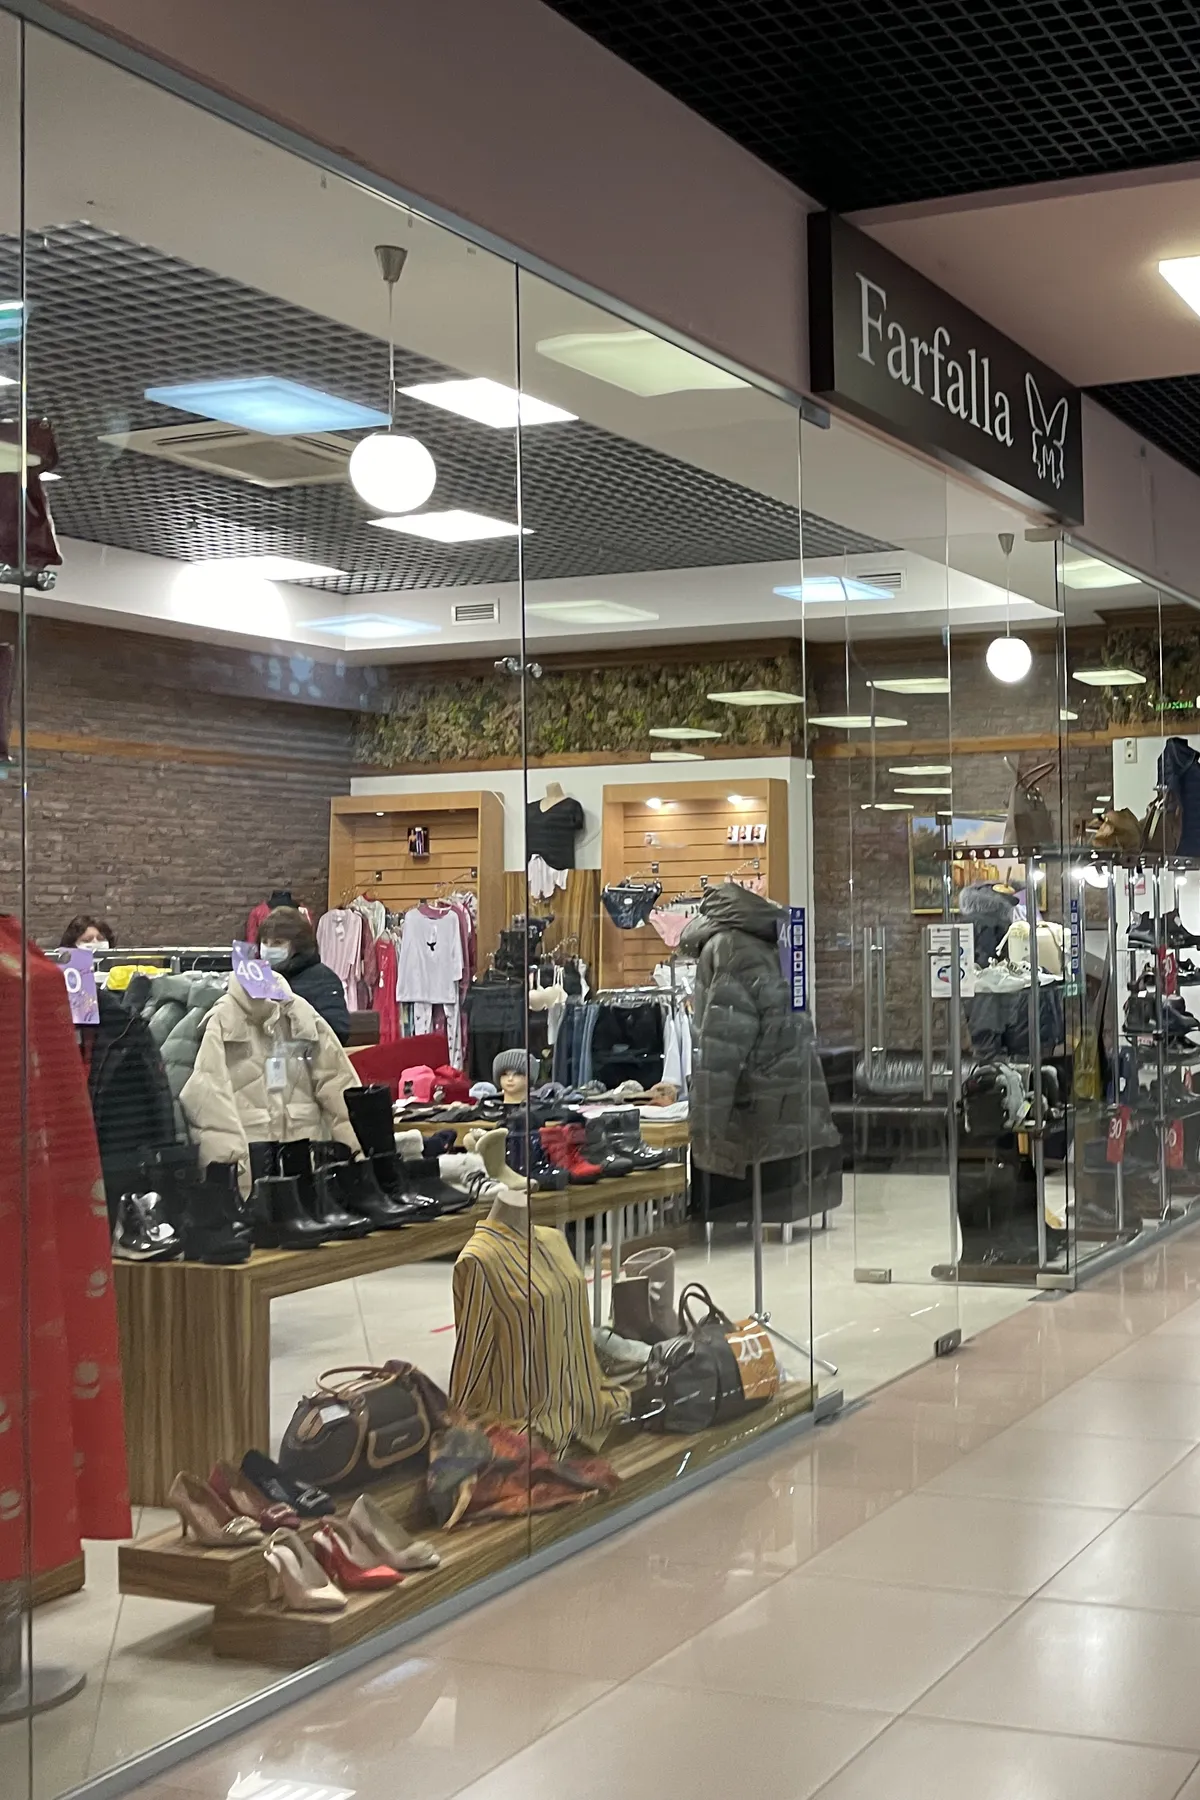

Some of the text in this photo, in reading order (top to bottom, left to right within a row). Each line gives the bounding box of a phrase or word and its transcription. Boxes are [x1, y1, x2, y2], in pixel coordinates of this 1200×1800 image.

[855, 272, 1014, 447] Farfalla
[236, 960, 264, 982] 40
[1109, 1117, 1122, 1140] 30
